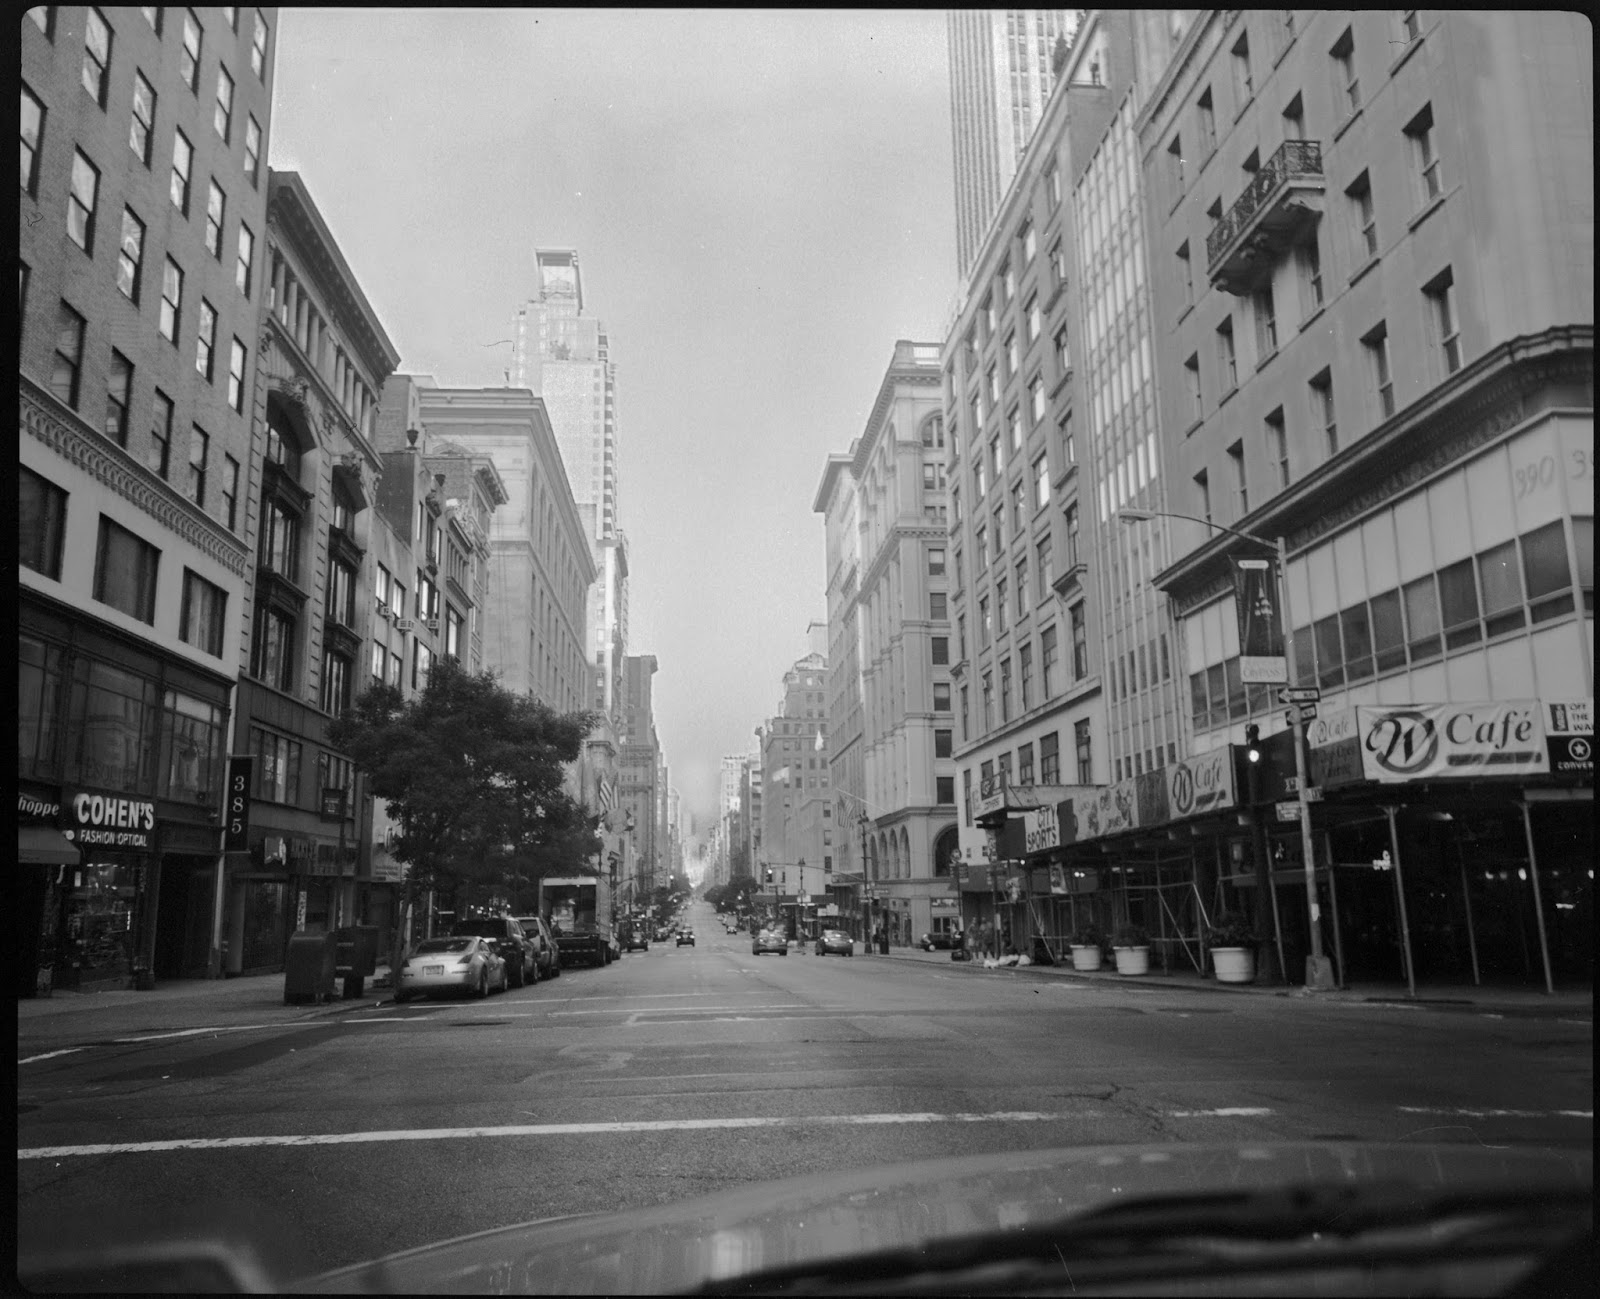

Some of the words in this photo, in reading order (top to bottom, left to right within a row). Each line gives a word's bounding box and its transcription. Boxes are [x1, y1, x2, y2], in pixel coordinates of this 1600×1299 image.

[1570, 449, 1593, 481] 3
[1446, 711, 1532, 749] Café
[77, 793, 155, 830] COHEN'S
[231, 775, 245, 834] 385
[1037, 804, 1057, 828] CITY
[80, 829, 115, 844] FASHION
[117, 833, 147, 847] OPTICAL
[1027, 825, 1057, 851] SPORTS
